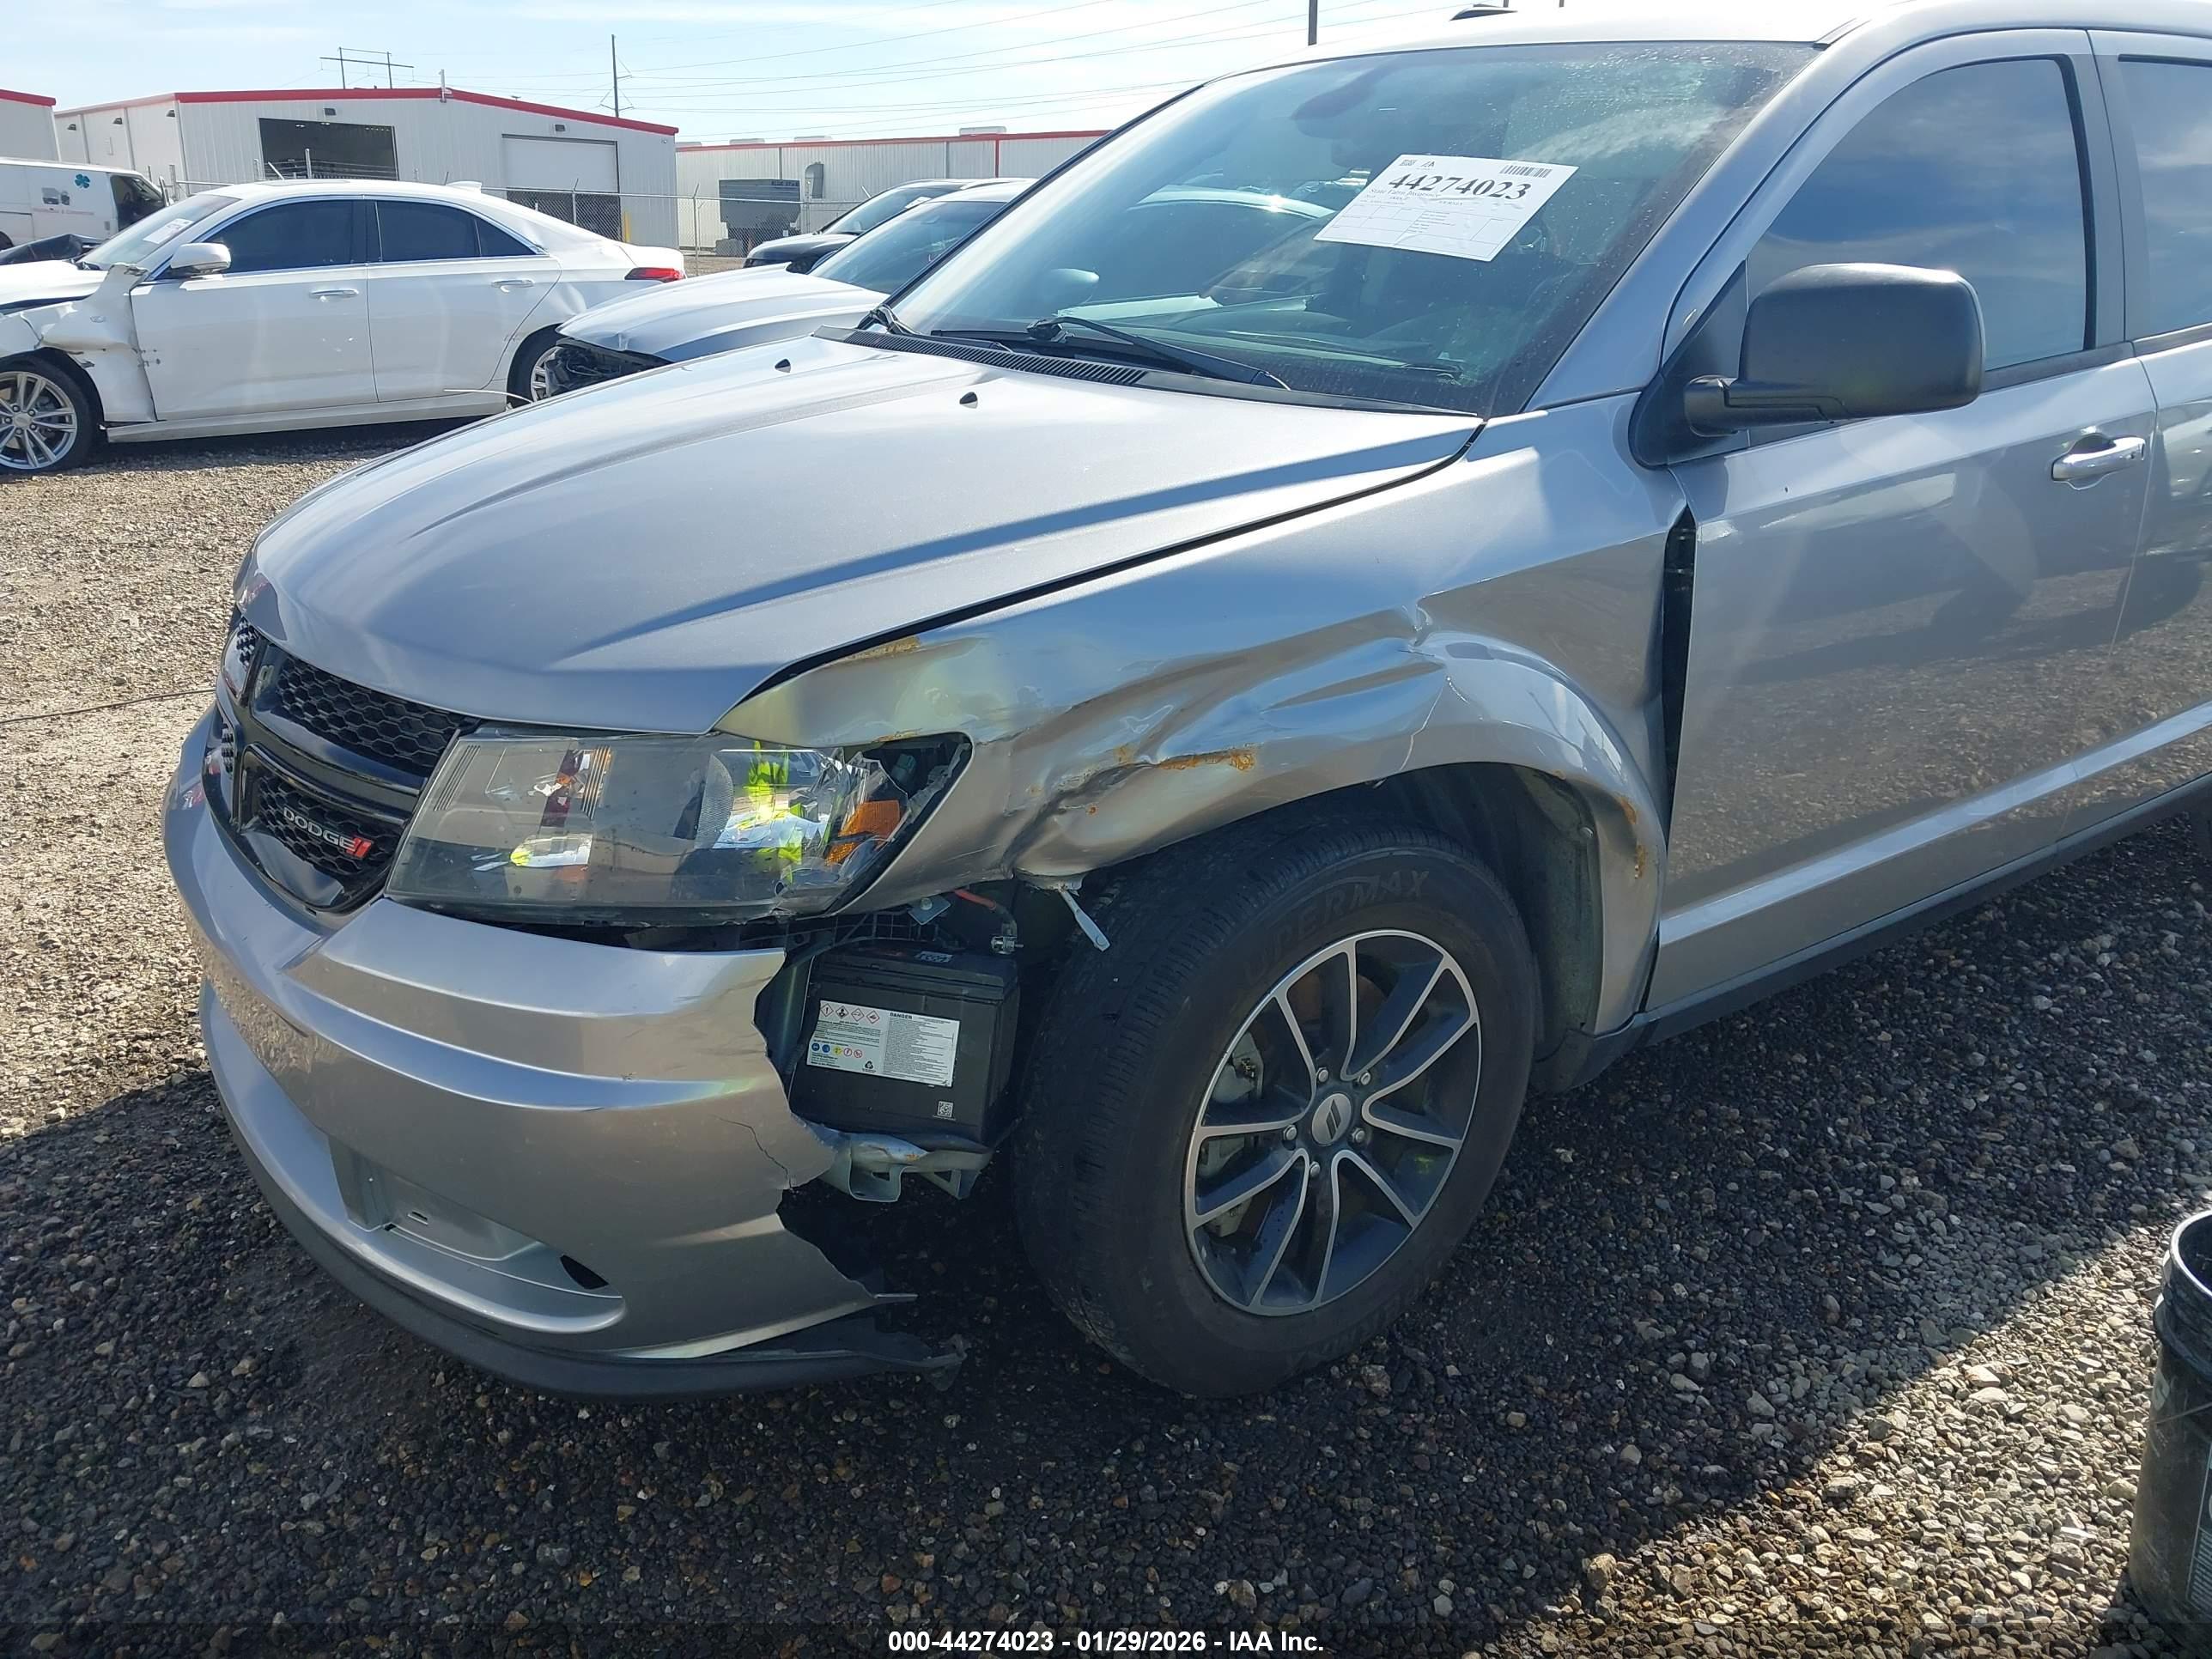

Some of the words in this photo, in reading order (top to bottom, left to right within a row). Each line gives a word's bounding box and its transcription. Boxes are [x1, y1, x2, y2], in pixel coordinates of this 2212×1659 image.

[1388, 173, 1532, 200] 44274023
[283, 807, 356, 852] DODGE
[890, 1012, 913, 1020] DANGER
